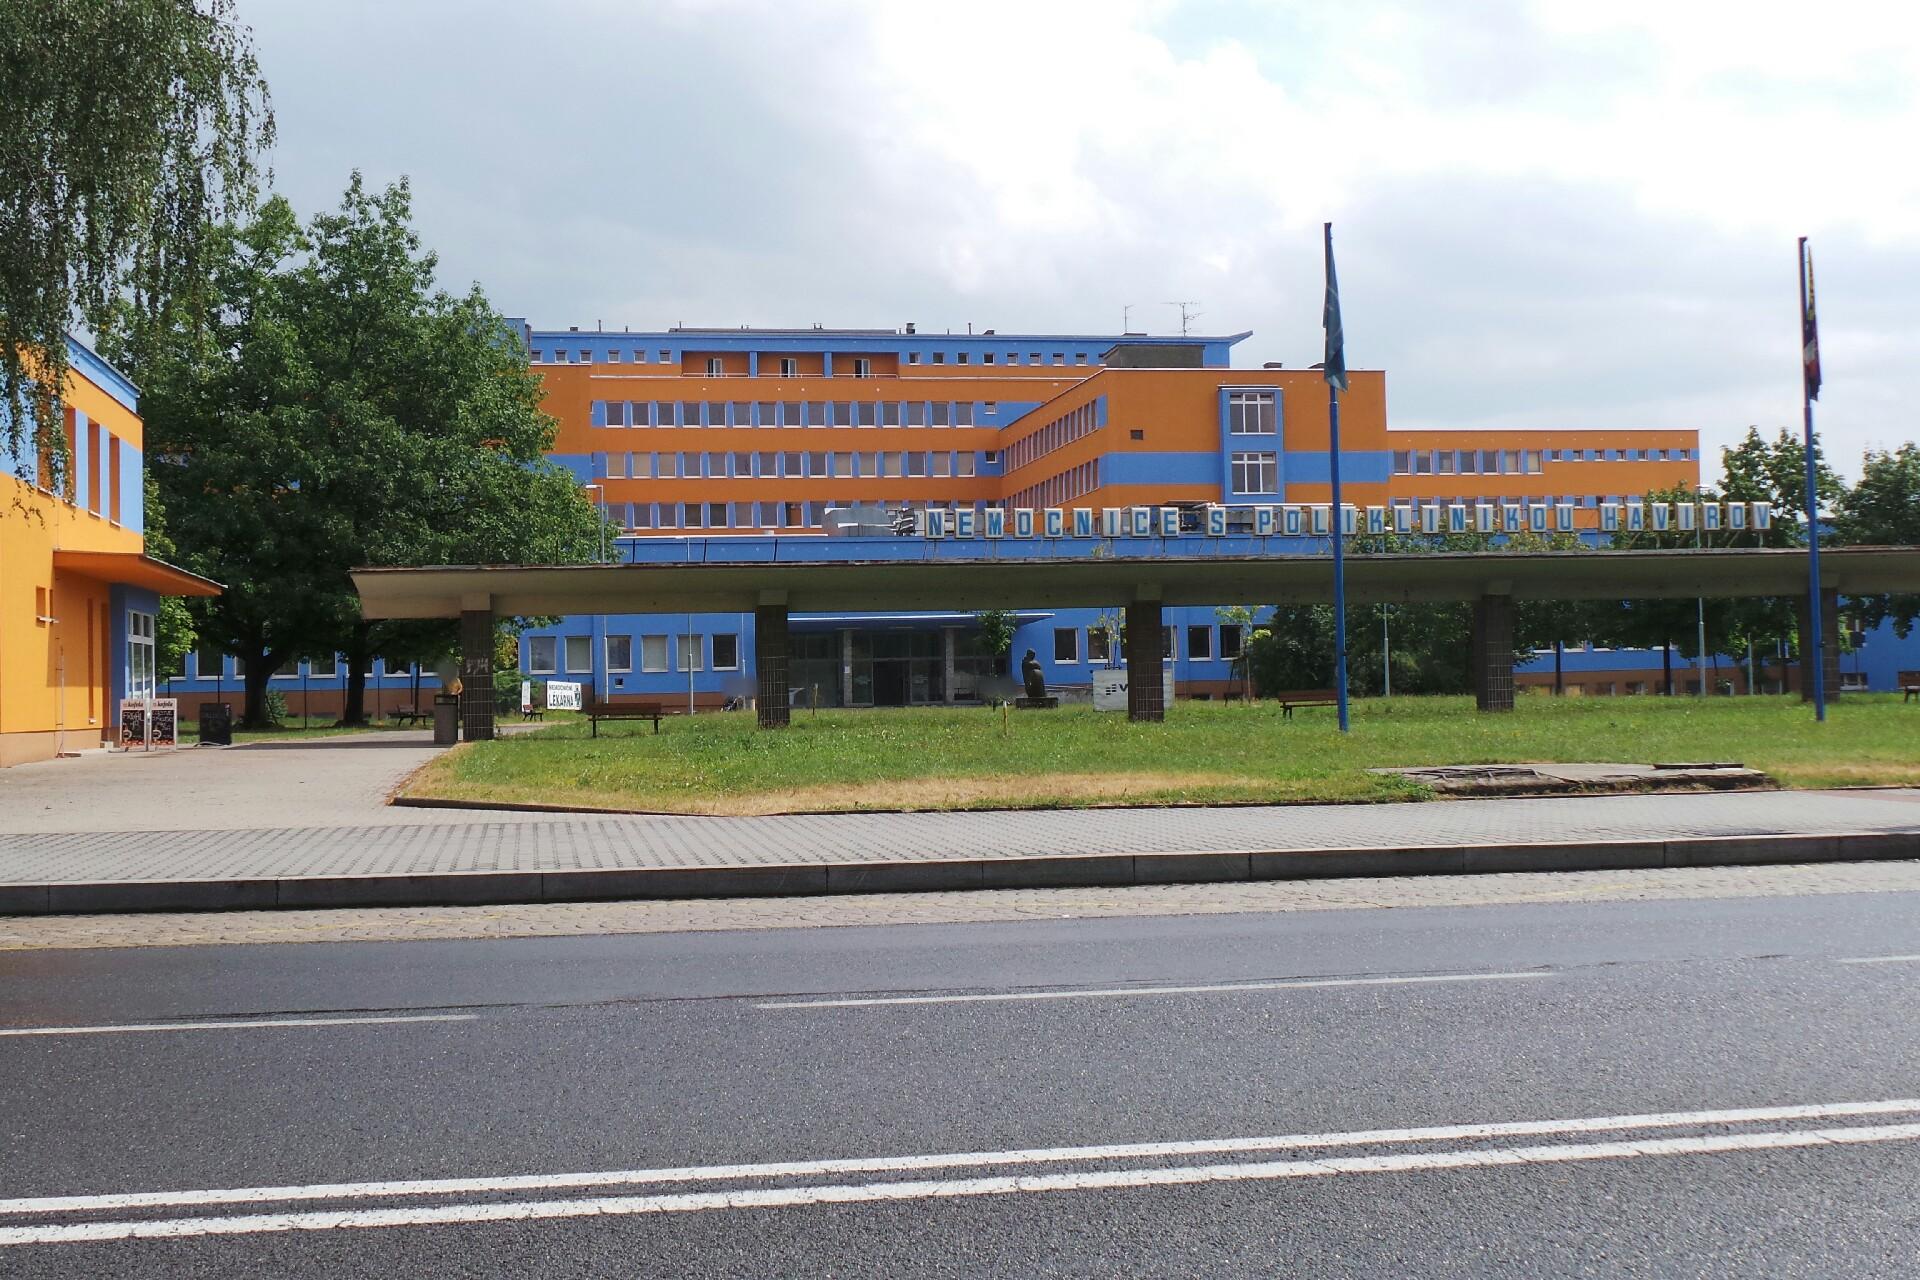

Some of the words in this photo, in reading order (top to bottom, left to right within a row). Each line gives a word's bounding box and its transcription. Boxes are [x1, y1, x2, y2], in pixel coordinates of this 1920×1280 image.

[928, 507, 1178, 537] NEMOCNICE
[1209, 507, 1223, 536] S
[1258, 505, 1574, 535] POLIKLINIKOU
